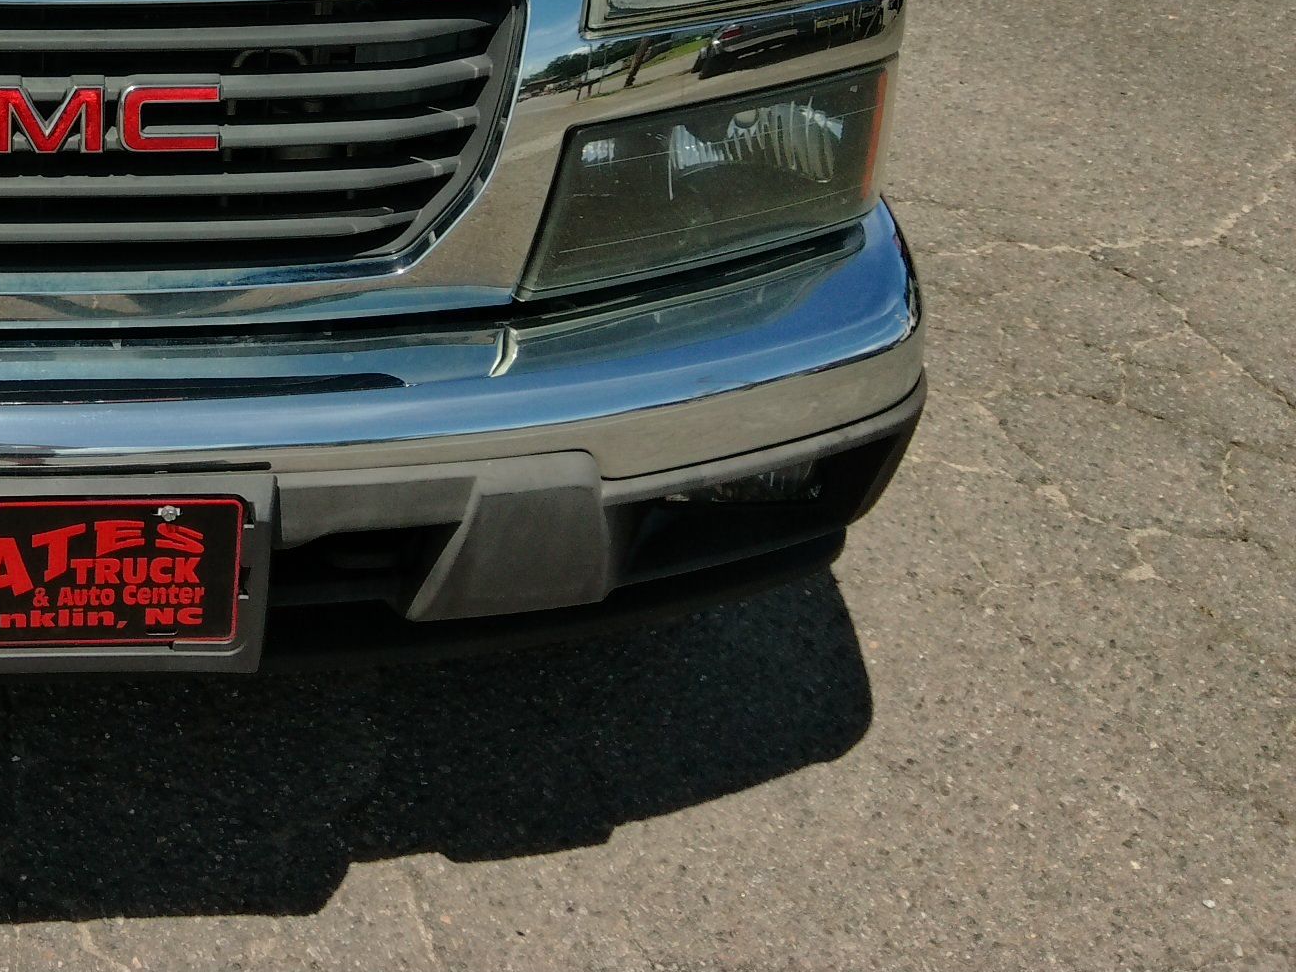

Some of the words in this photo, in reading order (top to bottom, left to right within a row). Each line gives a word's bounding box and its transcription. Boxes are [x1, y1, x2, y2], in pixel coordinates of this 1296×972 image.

[70, 557, 201, 584] TRUCK
[32, 587, 50, 607] &
[57, 585, 115, 607] Auto
[123, 584, 205, 605] Center
[145, 607, 203, 625] NC
